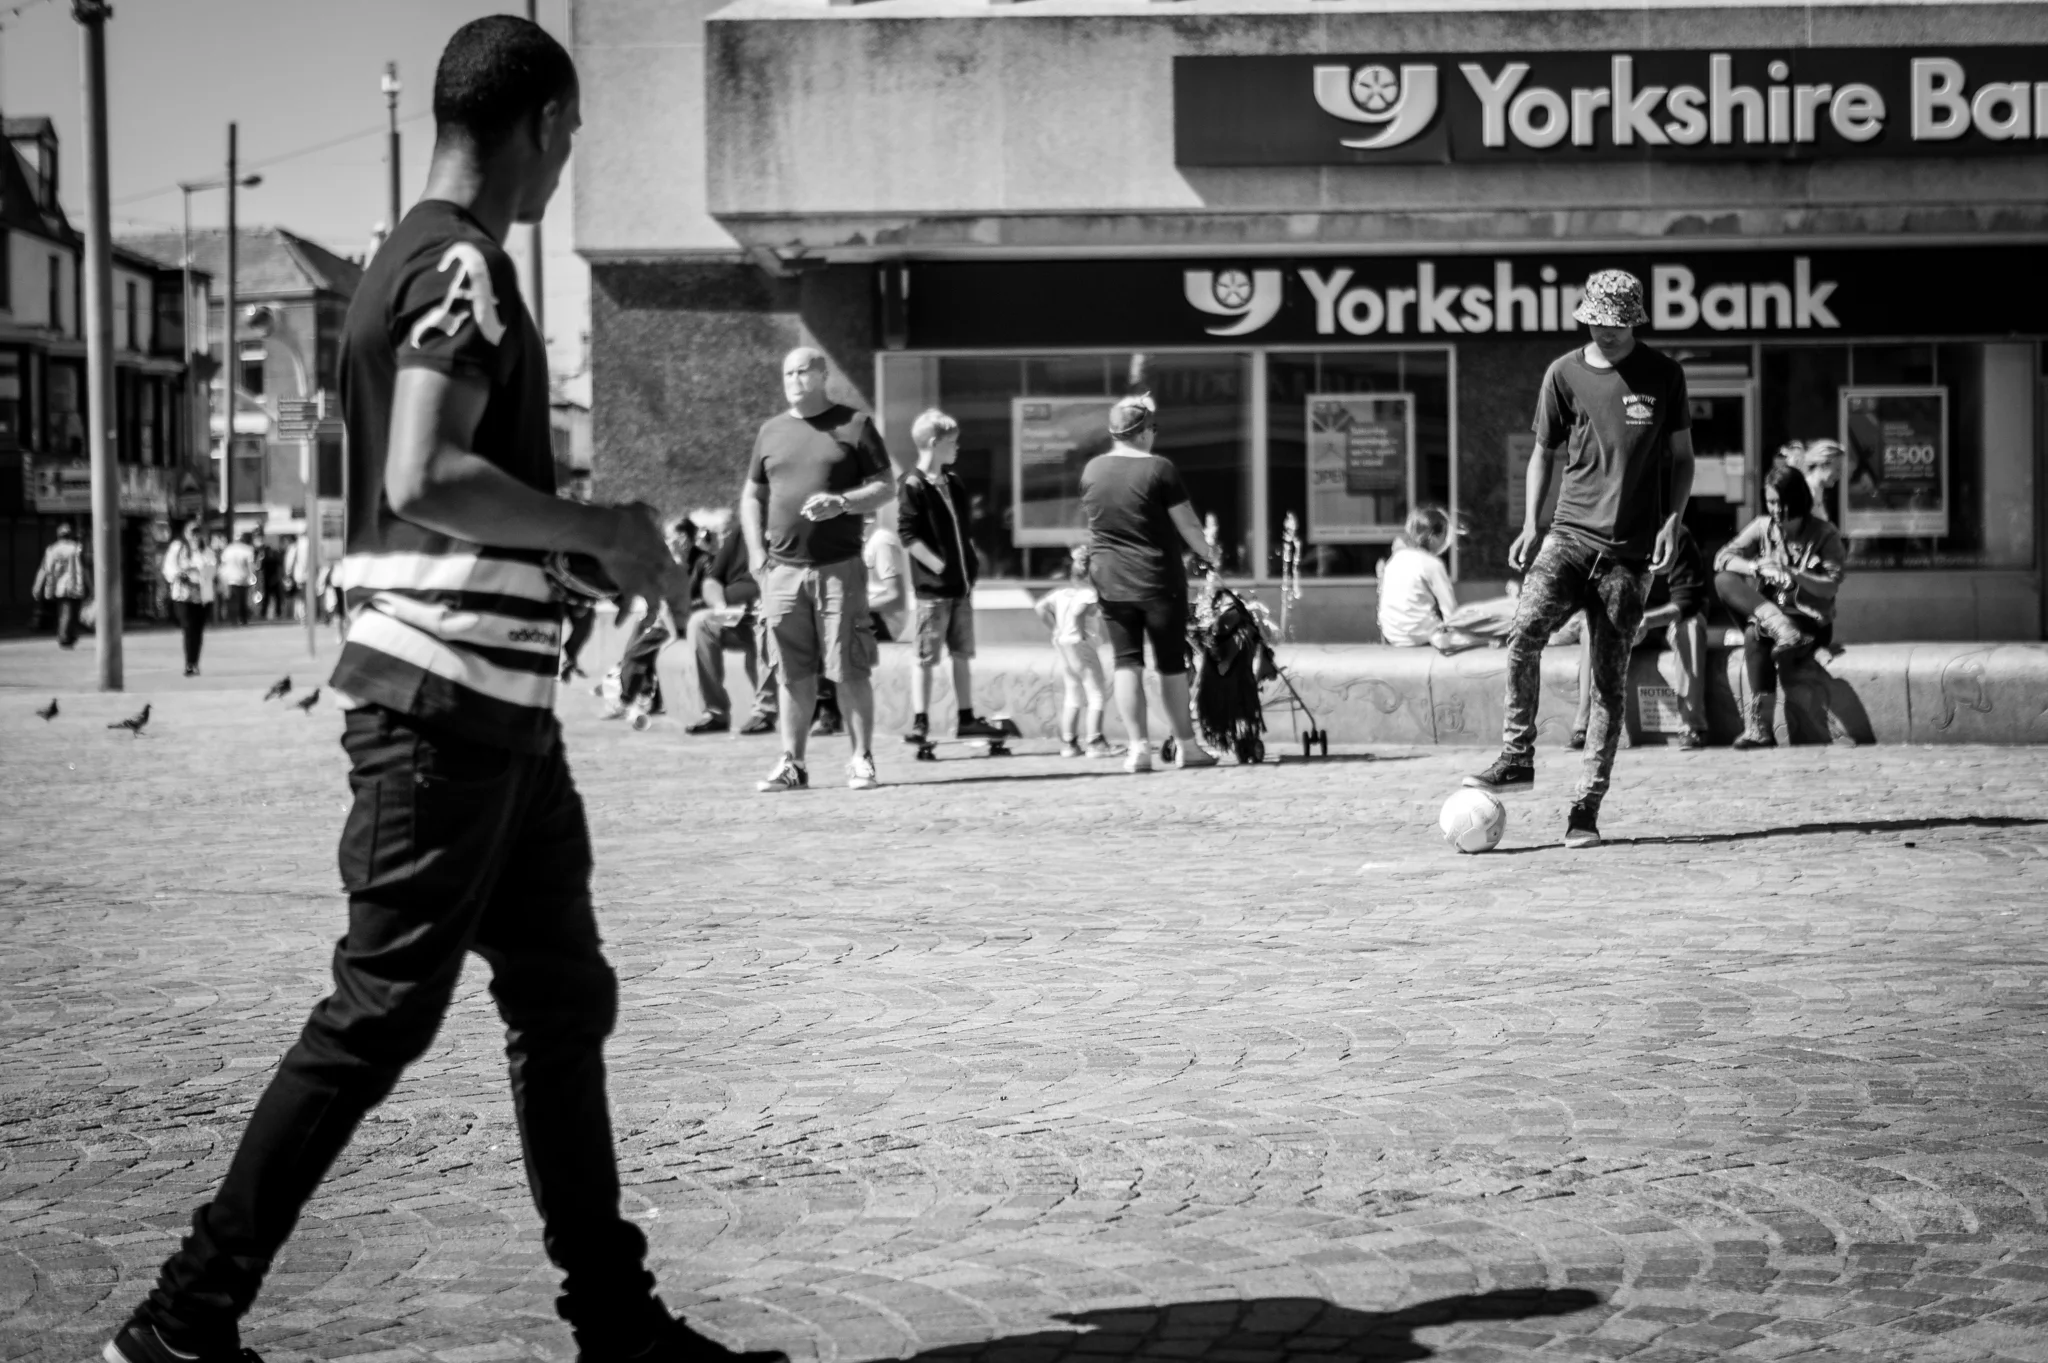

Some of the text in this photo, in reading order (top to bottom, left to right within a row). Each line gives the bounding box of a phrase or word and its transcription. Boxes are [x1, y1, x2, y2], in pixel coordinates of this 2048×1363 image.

[1459, 53, 1885, 147] Yorkshire
[1298, 258, 1841, 335] Yorkshir Bank
[1884, 444, 1935, 465] £500
